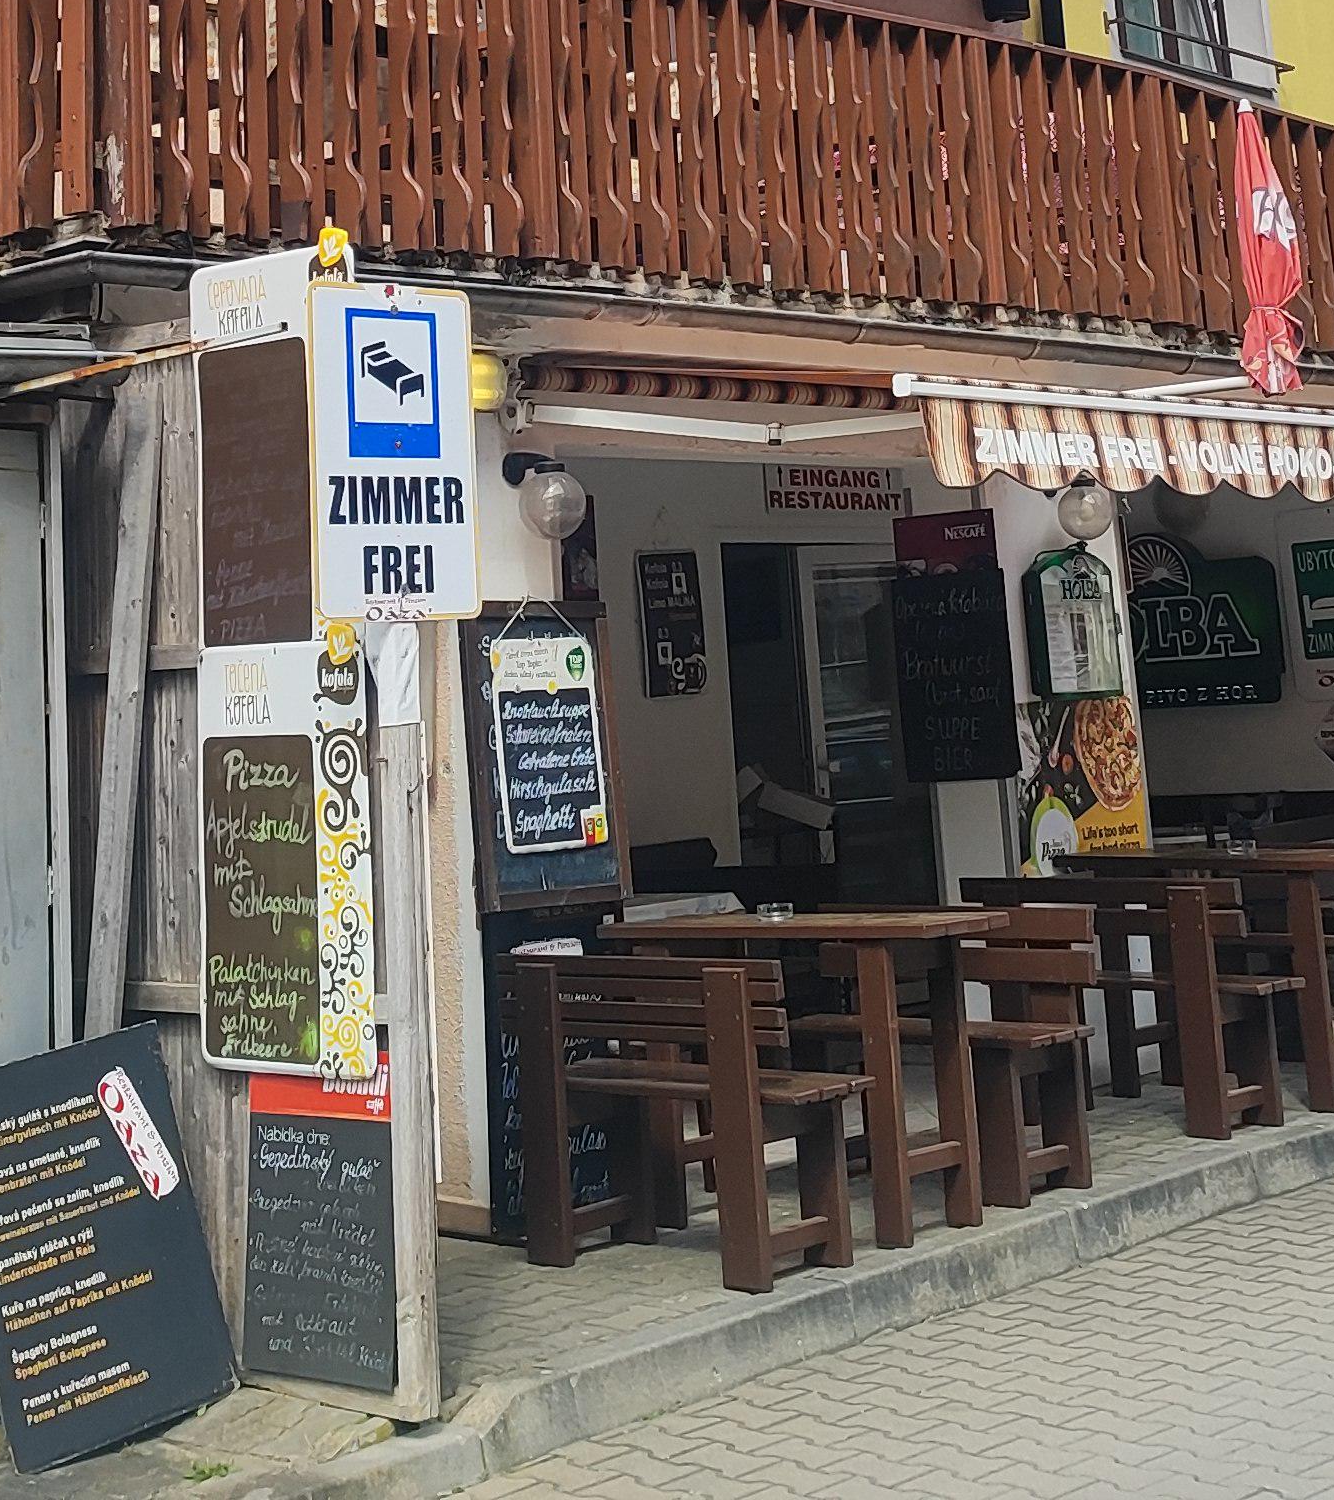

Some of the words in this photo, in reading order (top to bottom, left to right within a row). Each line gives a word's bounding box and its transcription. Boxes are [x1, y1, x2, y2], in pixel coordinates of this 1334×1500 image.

[973, 427, 1101, 469] ZIMMER
[1101, 435, 1164, 473] FREI
[1178, 436, 1266, 476] VOLNÉ
[328, 475, 465, 526] ZIMMER
[768, 490, 902, 512] RESTAURANT
[789, 468, 881, 489] EINGANG
[363, 544, 435, 595] FREI
[321, 667, 355, 692] kofola
[1196, 686, 1208, 701] Z
[223, 748, 301, 793] Pizza
[206, 799, 313, 859] Apfelstrudel
